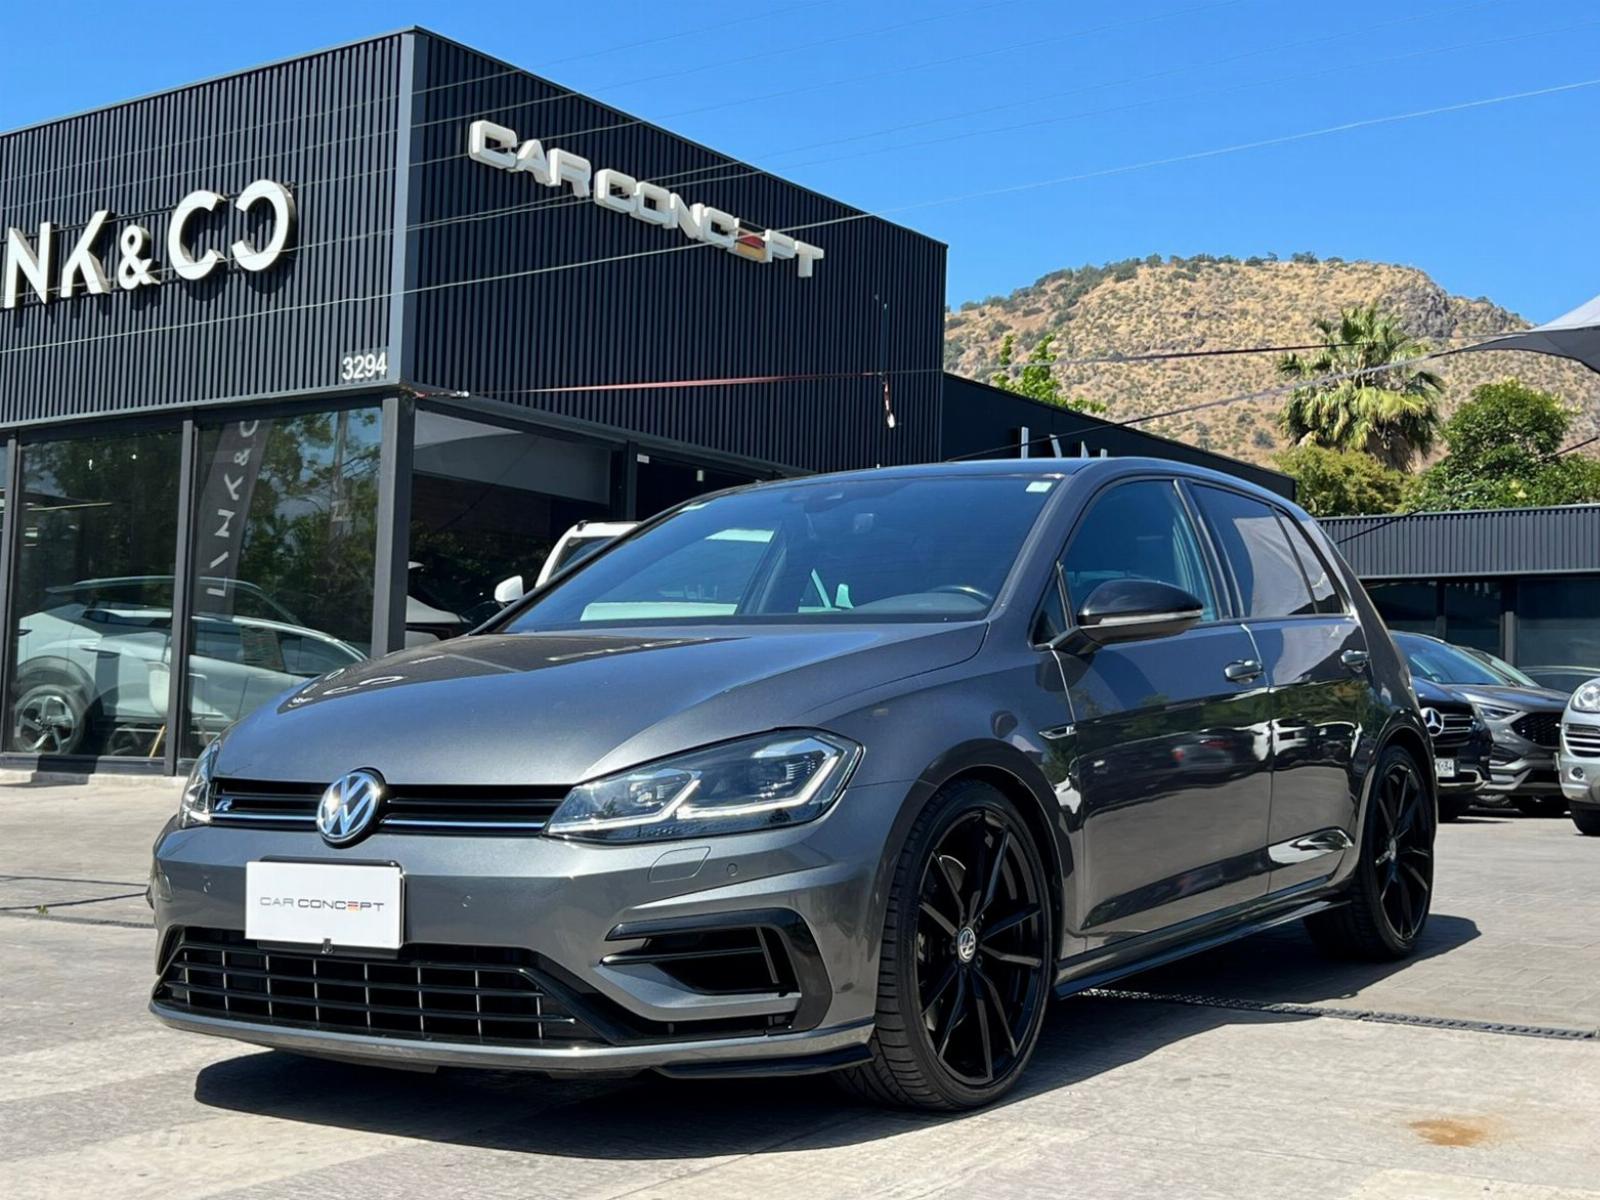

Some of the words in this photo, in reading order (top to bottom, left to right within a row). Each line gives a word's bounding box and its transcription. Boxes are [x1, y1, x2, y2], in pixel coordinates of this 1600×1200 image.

[469, 120, 591, 197] CAR
[594, 168, 824, 277] CONCEPT
[342, 352, 387, 380] 3294
[259, 897, 294, 908] CAR
[298, 899, 384, 912] CONCEPT
